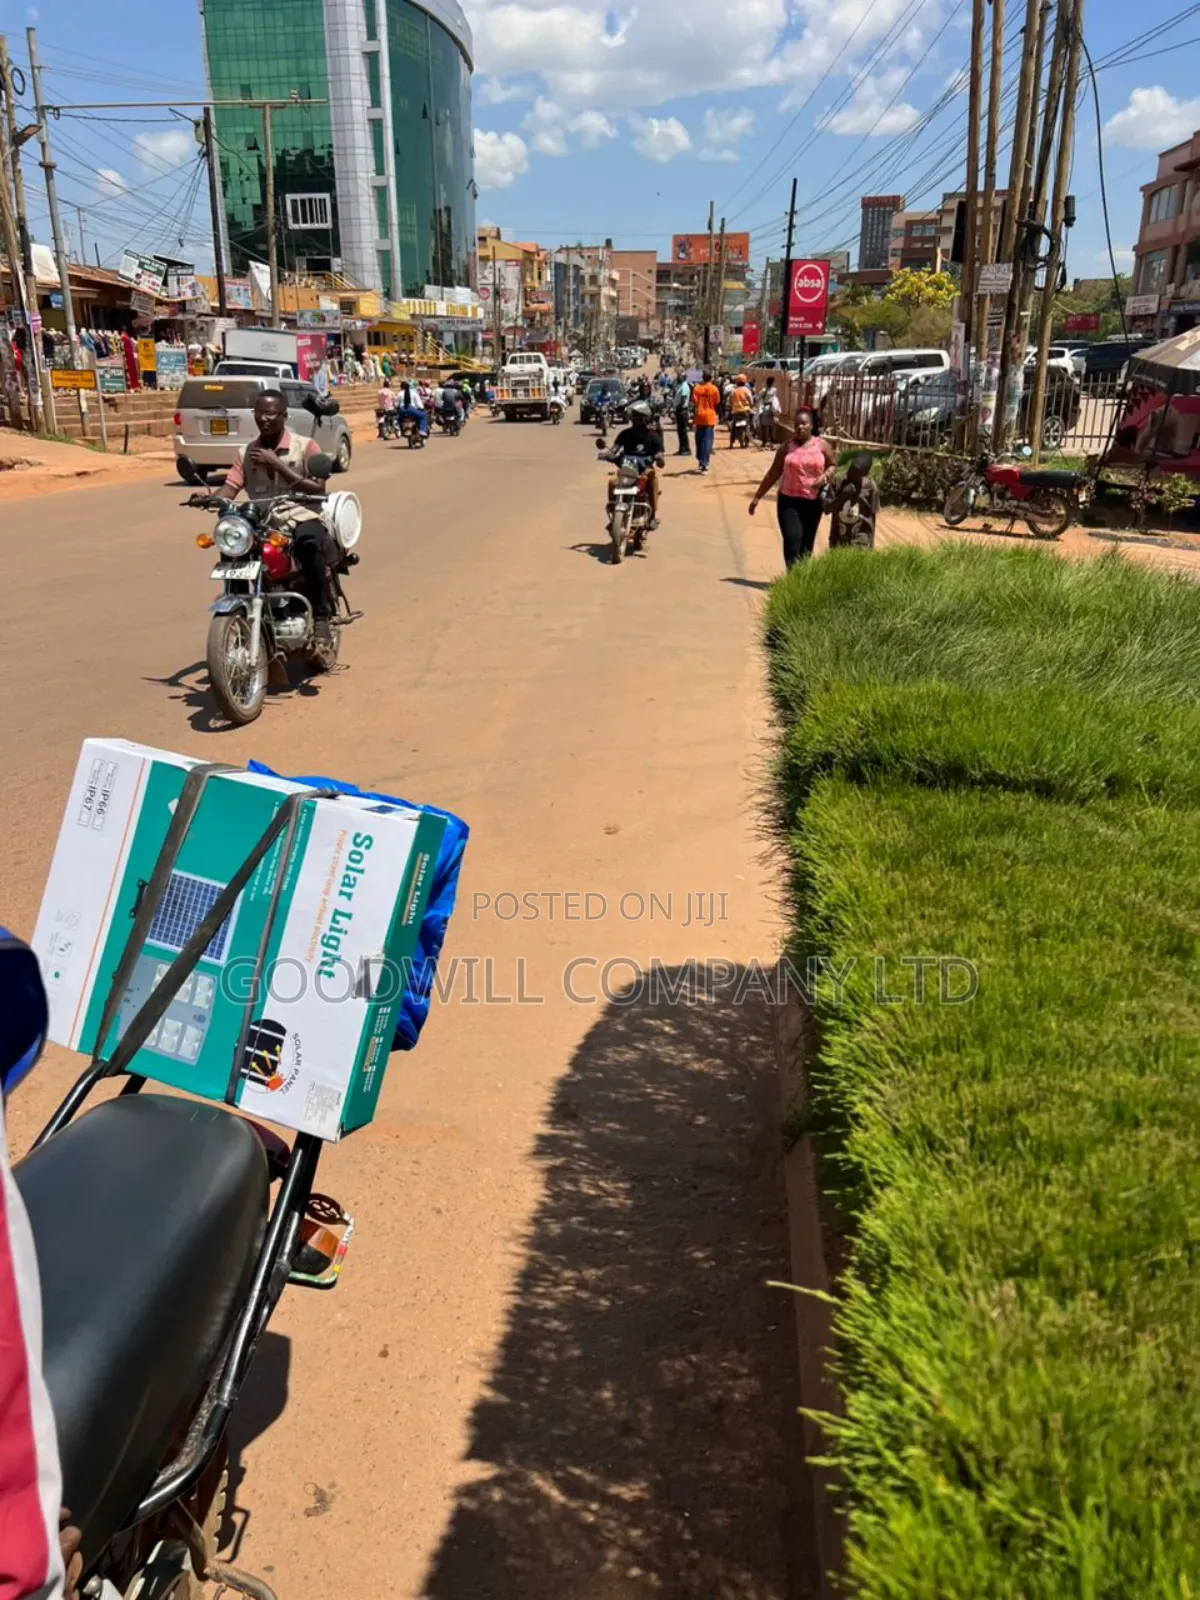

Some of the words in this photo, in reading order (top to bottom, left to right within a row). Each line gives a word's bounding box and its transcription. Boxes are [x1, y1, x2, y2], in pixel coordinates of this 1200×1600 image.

[798, 275, 822, 288] absa
[83, 785, 97, 811] IP67
[96, 789, 111, 815] IP66
[337, 832, 374, 901] Solar
[417, 853, 430, 888] Solar
[407, 890, 421, 925] Light
[317, 908, 353, 979] Light
[292, 1032, 303, 1066] SOLAR
[279, 1068, 300, 1095] PANEL
